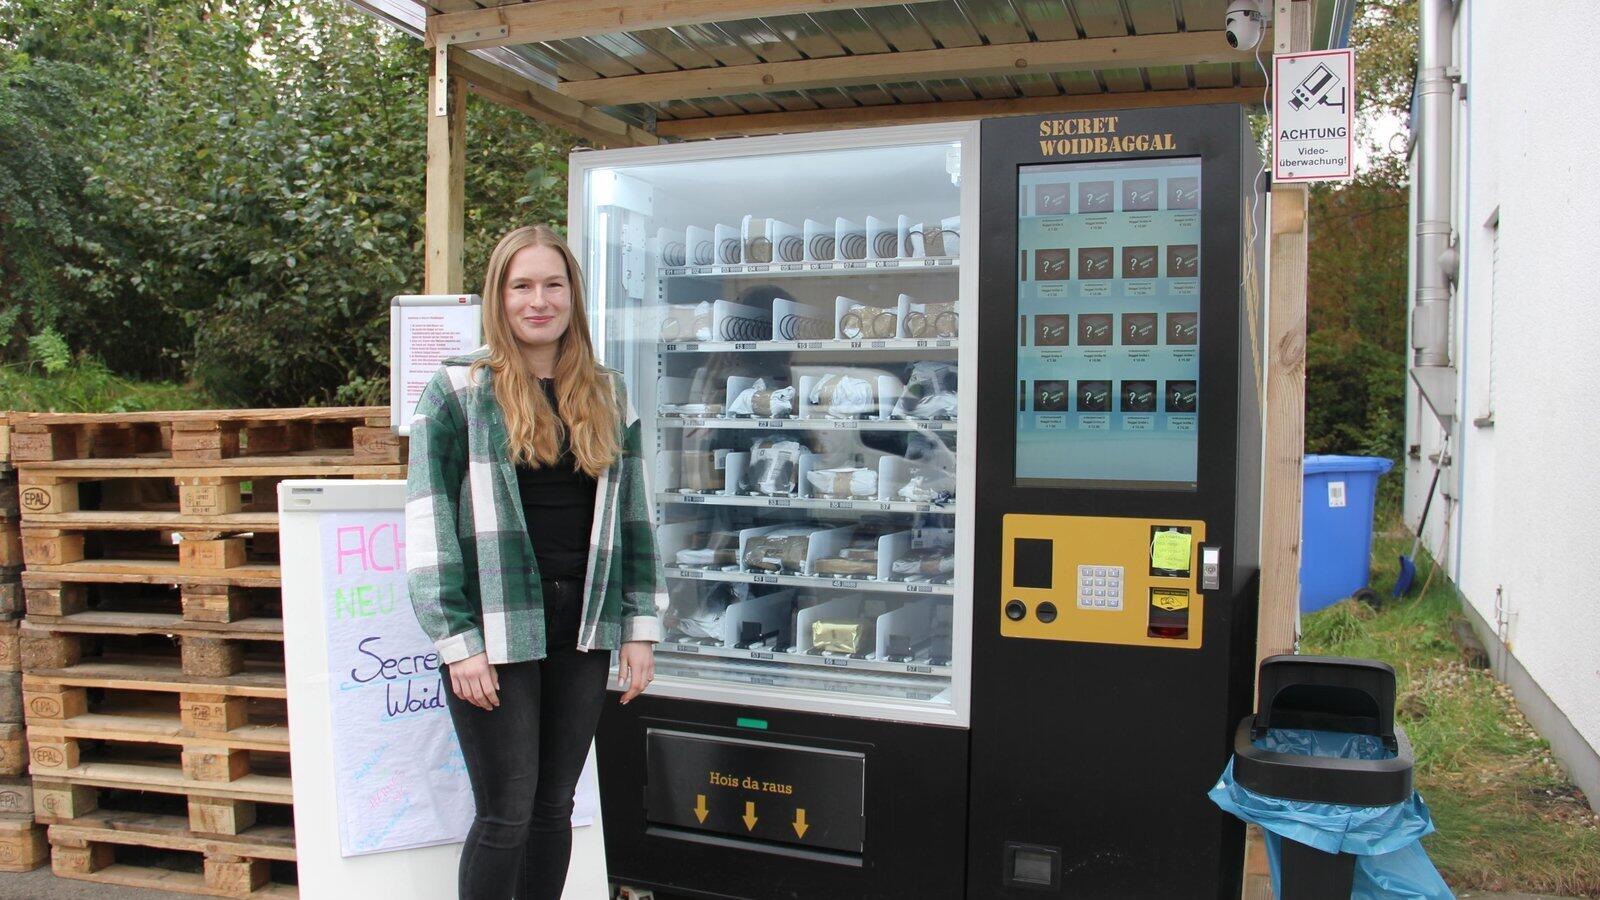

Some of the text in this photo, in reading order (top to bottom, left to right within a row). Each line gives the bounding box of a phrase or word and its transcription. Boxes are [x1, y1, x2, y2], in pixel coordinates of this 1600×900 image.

[1039, 116, 1119, 137] SECRET
[1280, 127, 1347, 140] ACHTUNG
[1039, 133, 1176, 156] WOIDBAGGAL
[1298, 147, 1328, 155] Video-
[1280, 156, 1347, 167] überwachung!
[24, 491, 47, 507] EPAL
[334, 584, 396, 620] NEU
[37, 750, 60, 763] EPAL
[710, 772, 793, 795] Hois da raus
